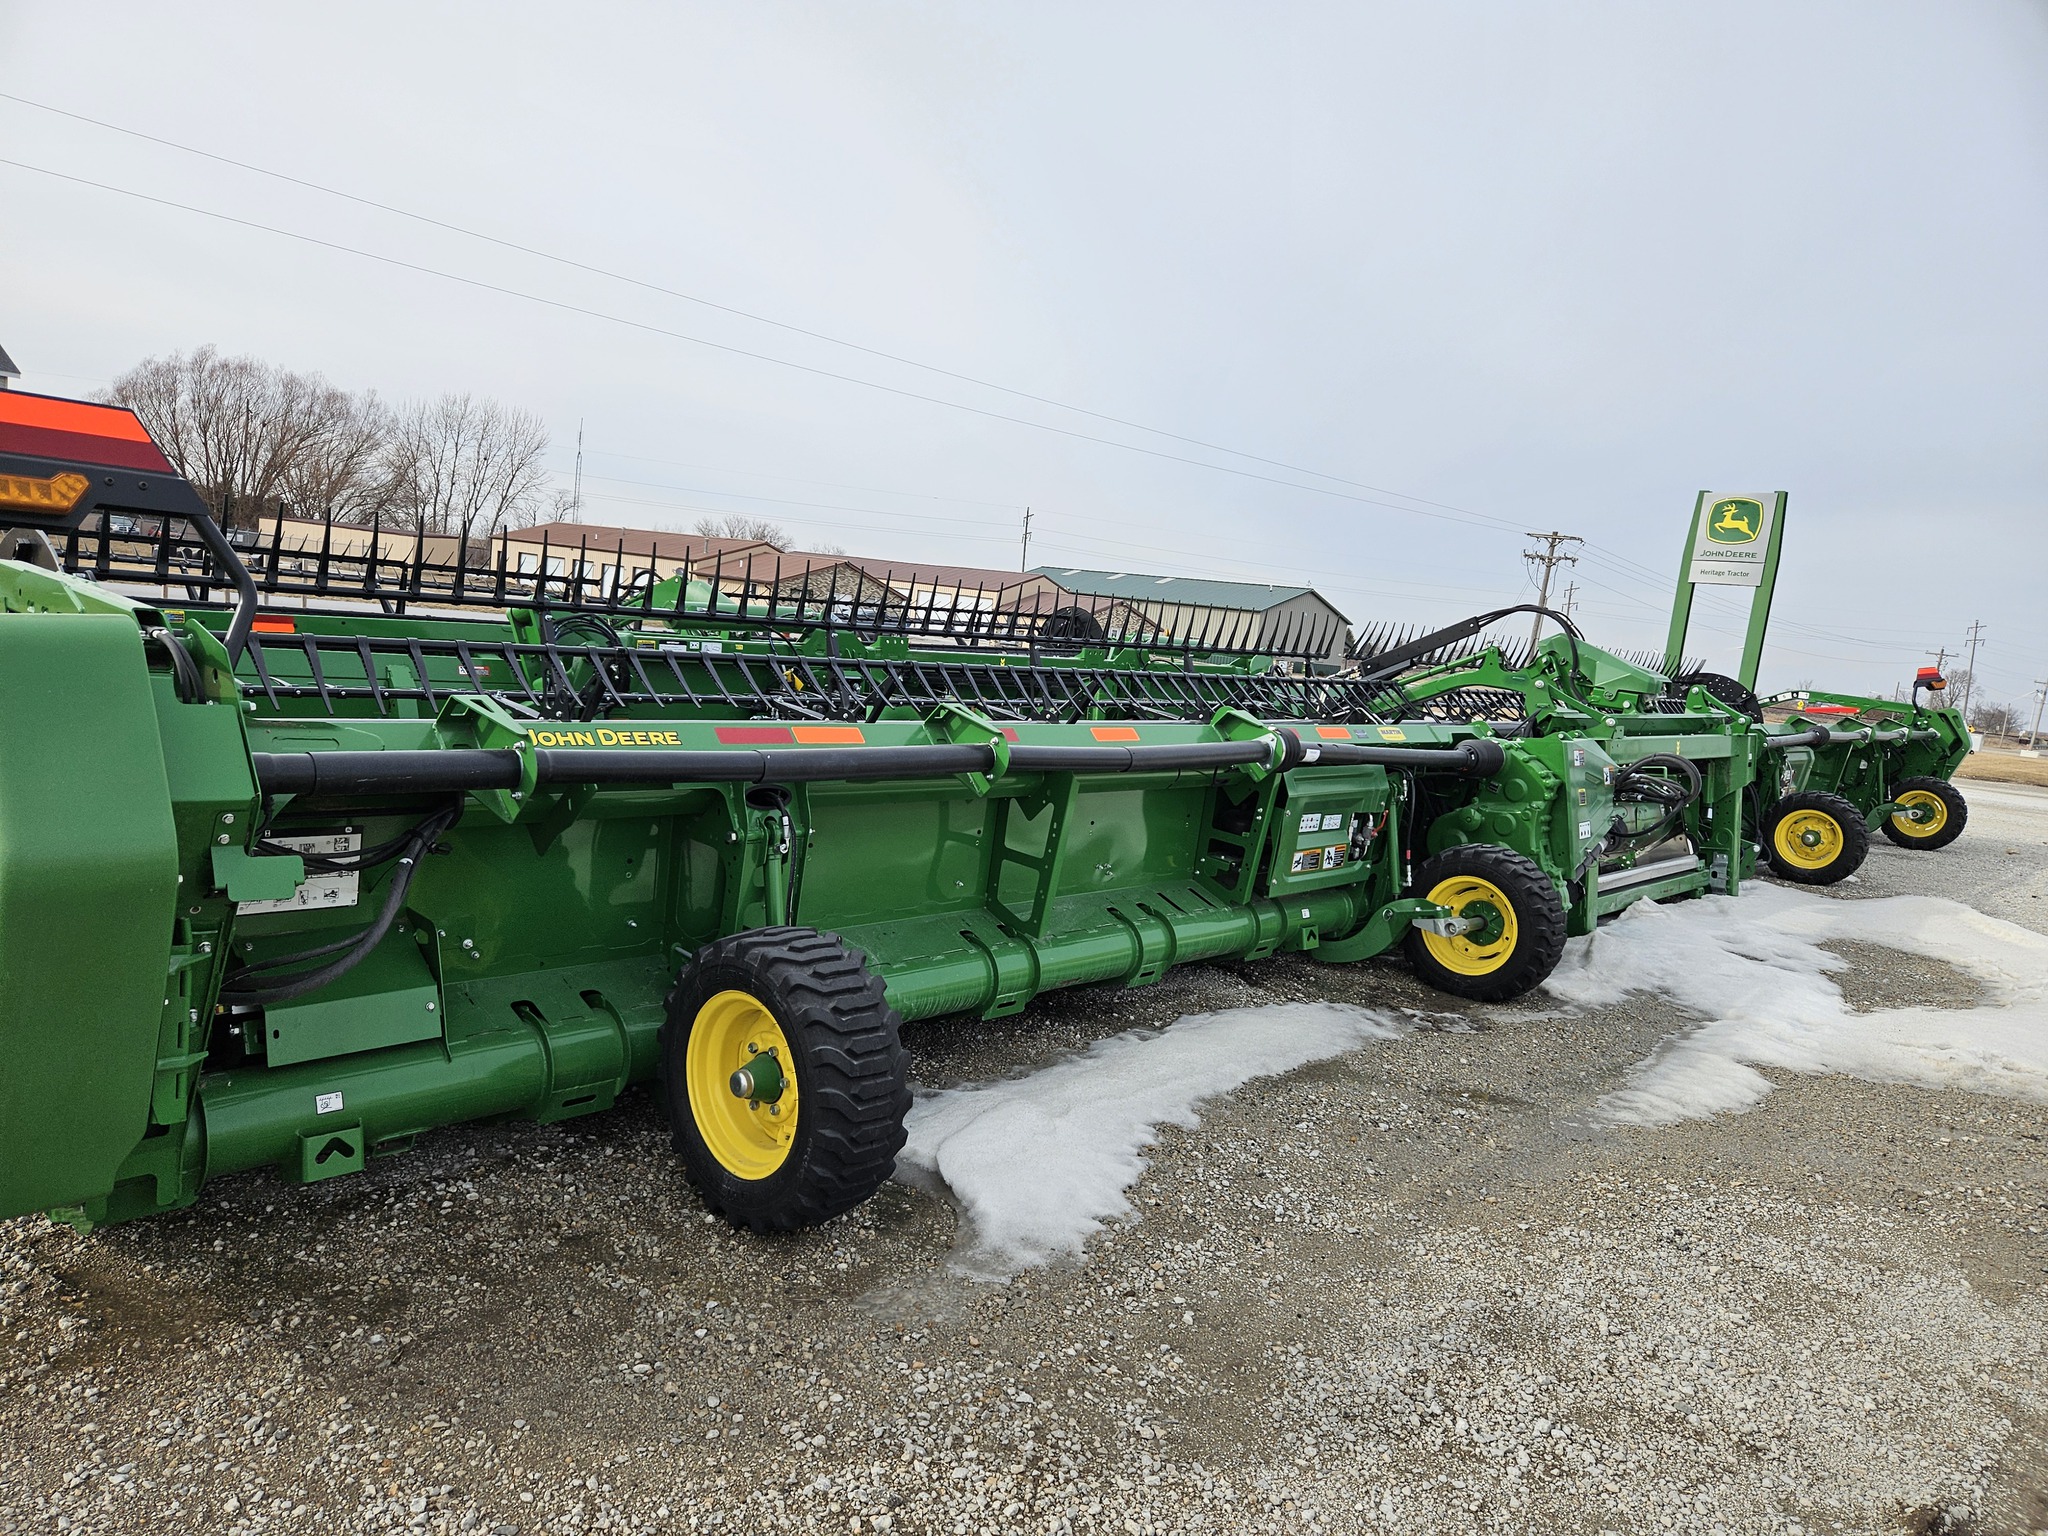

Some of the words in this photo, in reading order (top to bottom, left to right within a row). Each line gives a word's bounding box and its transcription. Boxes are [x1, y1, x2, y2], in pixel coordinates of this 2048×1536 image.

[1700, 549, 1725, 557] JOHN
[1725, 550, 1758, 559] DEERE
[1700, 569, 1726, 577] Heritage
[527, 728, 596, 746] JOHN
[595, 728, 682, 746] DEERE
